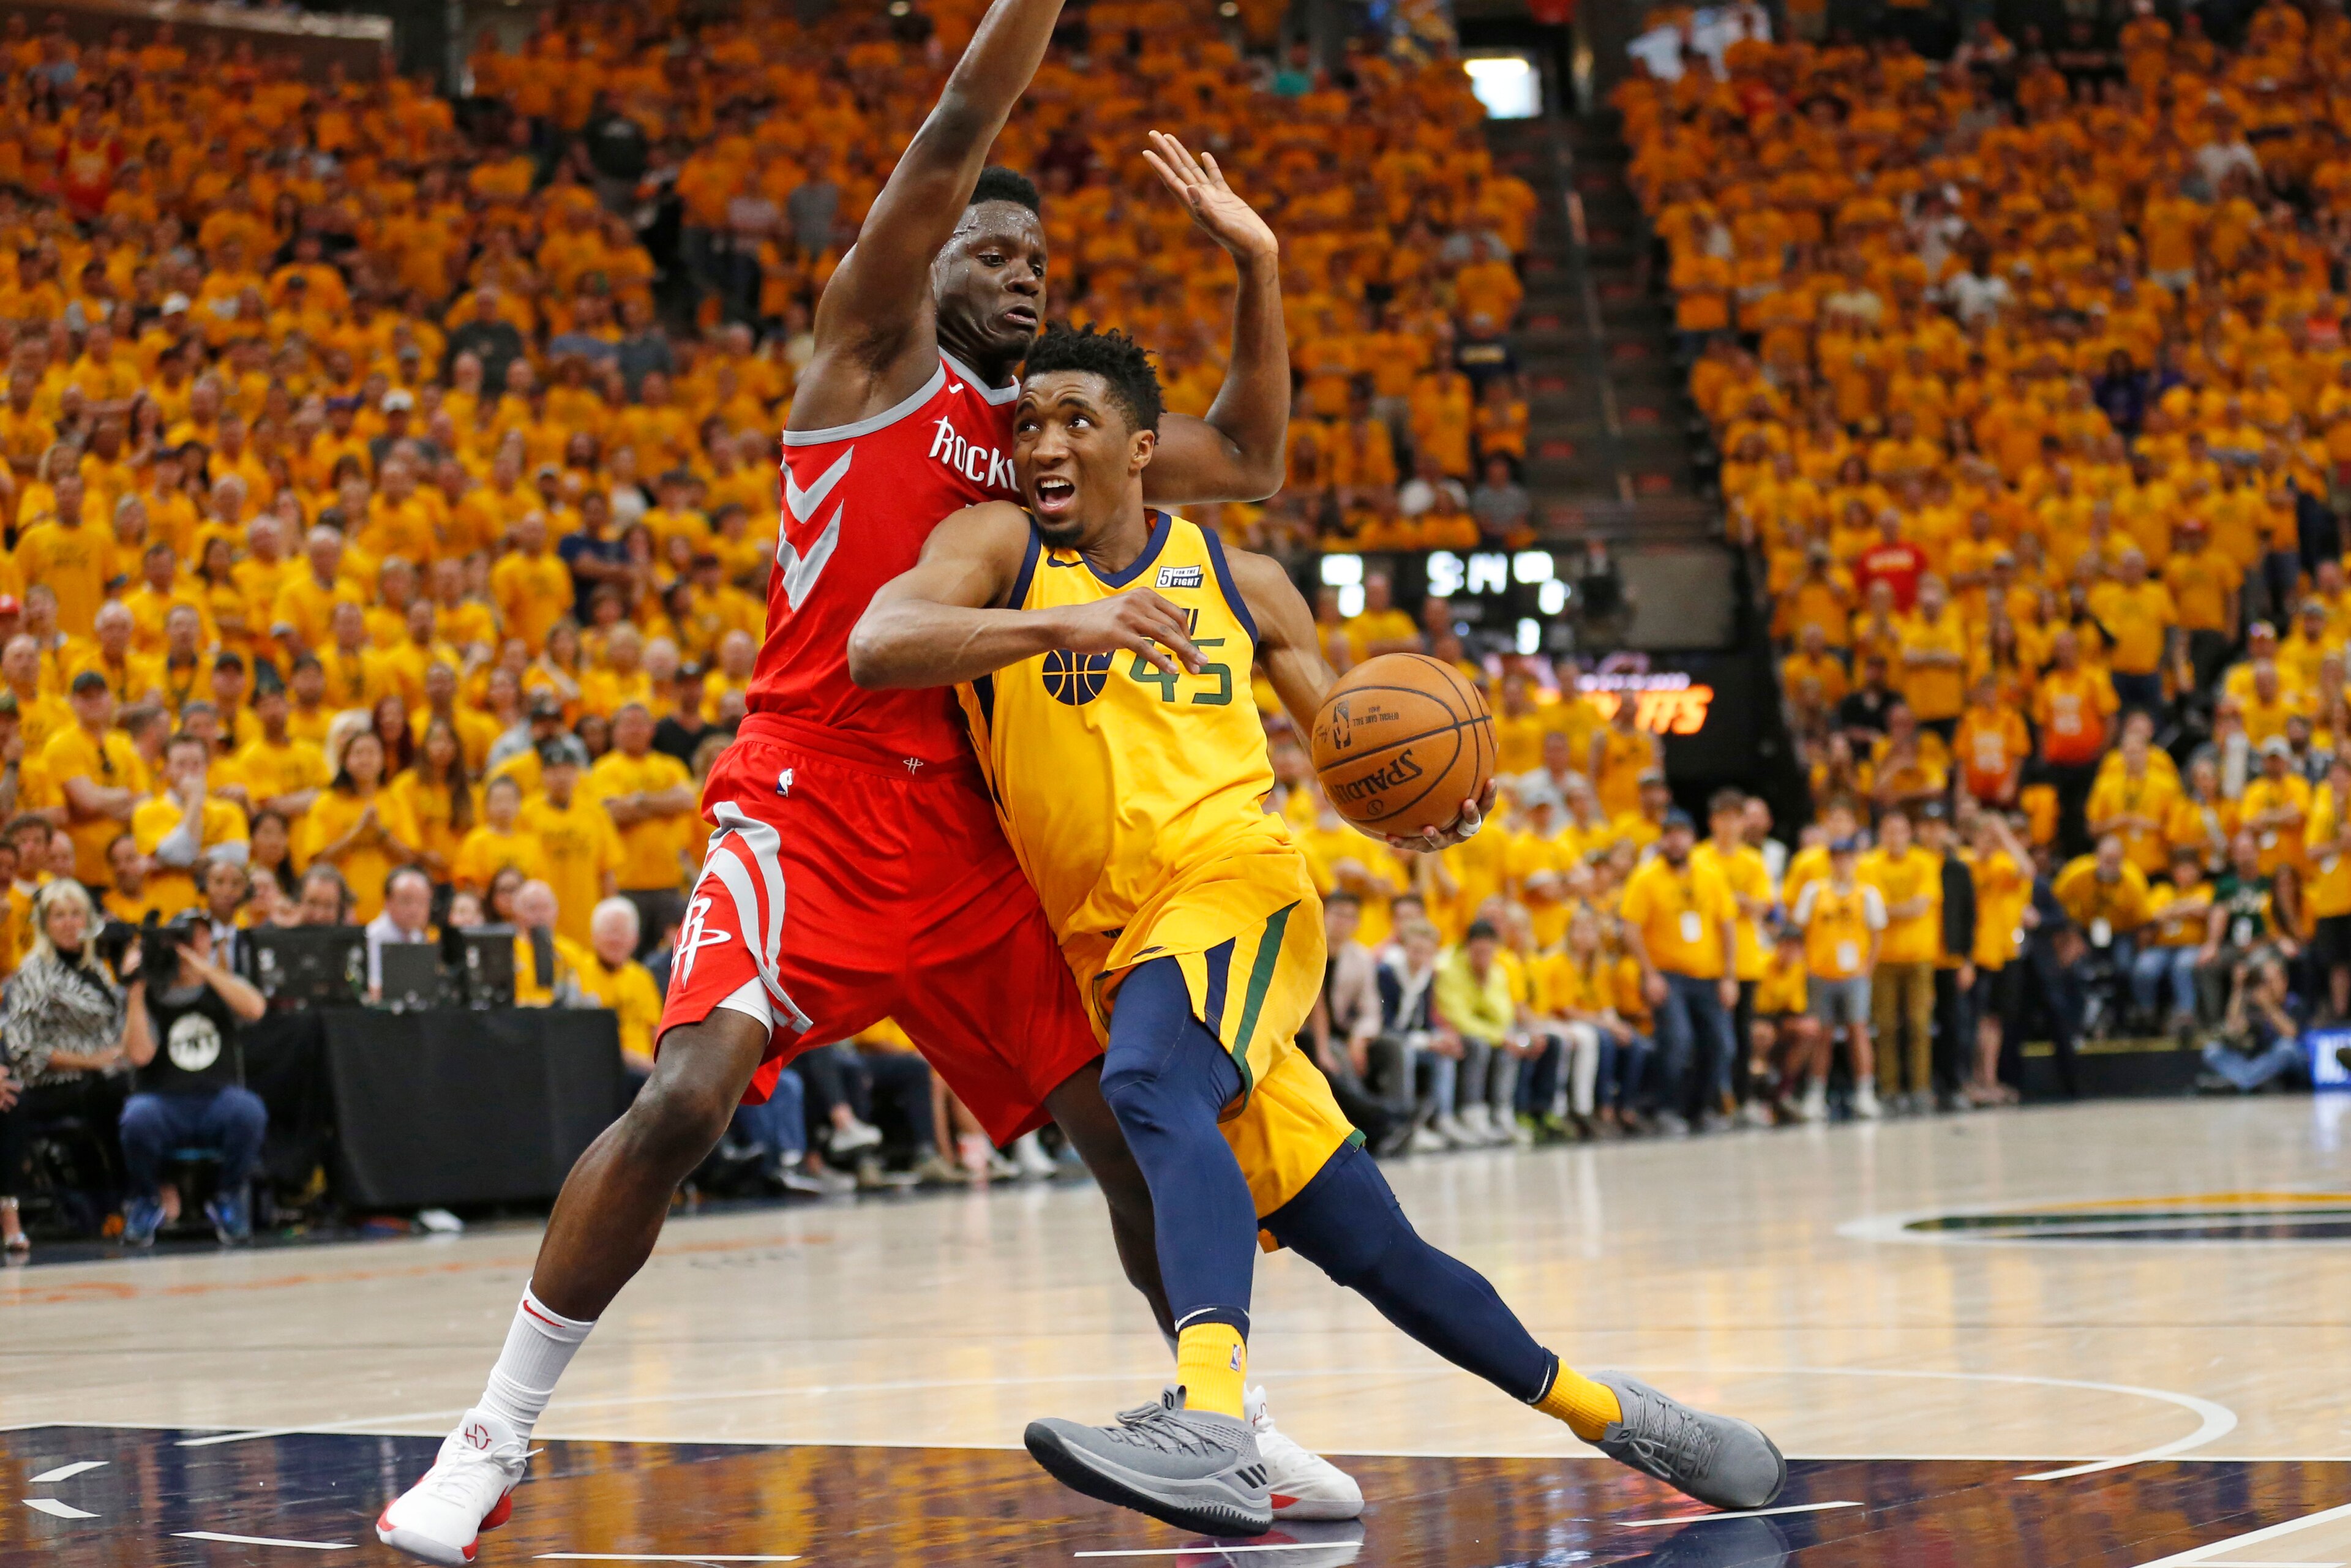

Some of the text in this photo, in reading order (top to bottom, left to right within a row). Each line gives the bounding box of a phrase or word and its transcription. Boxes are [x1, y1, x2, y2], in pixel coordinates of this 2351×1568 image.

[1160, 569, 1170, 585] 5
[1172, 577, 1200, 586] FIGHT
[1129, 638, 1232, 706] 45
[1352, 717, 1363, 726] BALL
